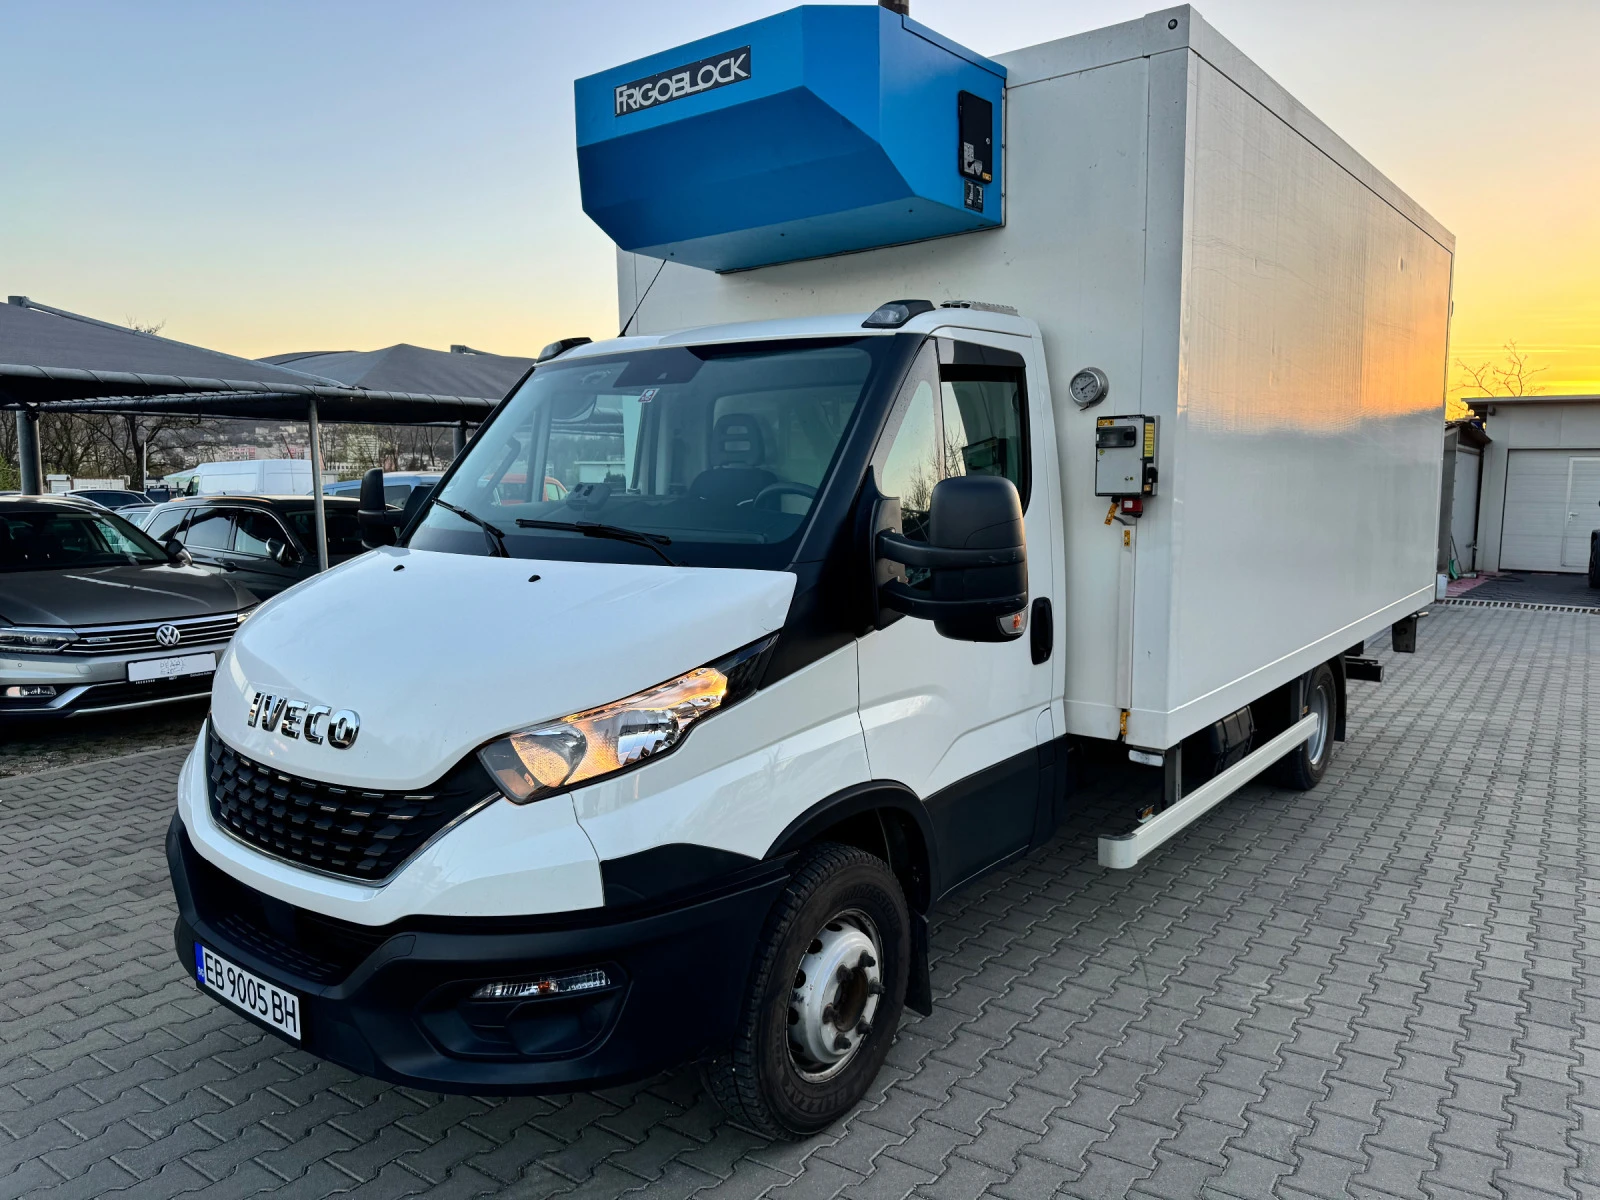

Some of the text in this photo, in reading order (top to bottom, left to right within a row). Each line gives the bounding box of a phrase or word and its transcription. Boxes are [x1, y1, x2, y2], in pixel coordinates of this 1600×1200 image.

[616, 53, 747, 114] FRIGOBLOCK
[156, 625, 180, 646] VW
[247, 691, 361, 750] IVECO
[205, 952, 297, 1033] EB 9005 BH
